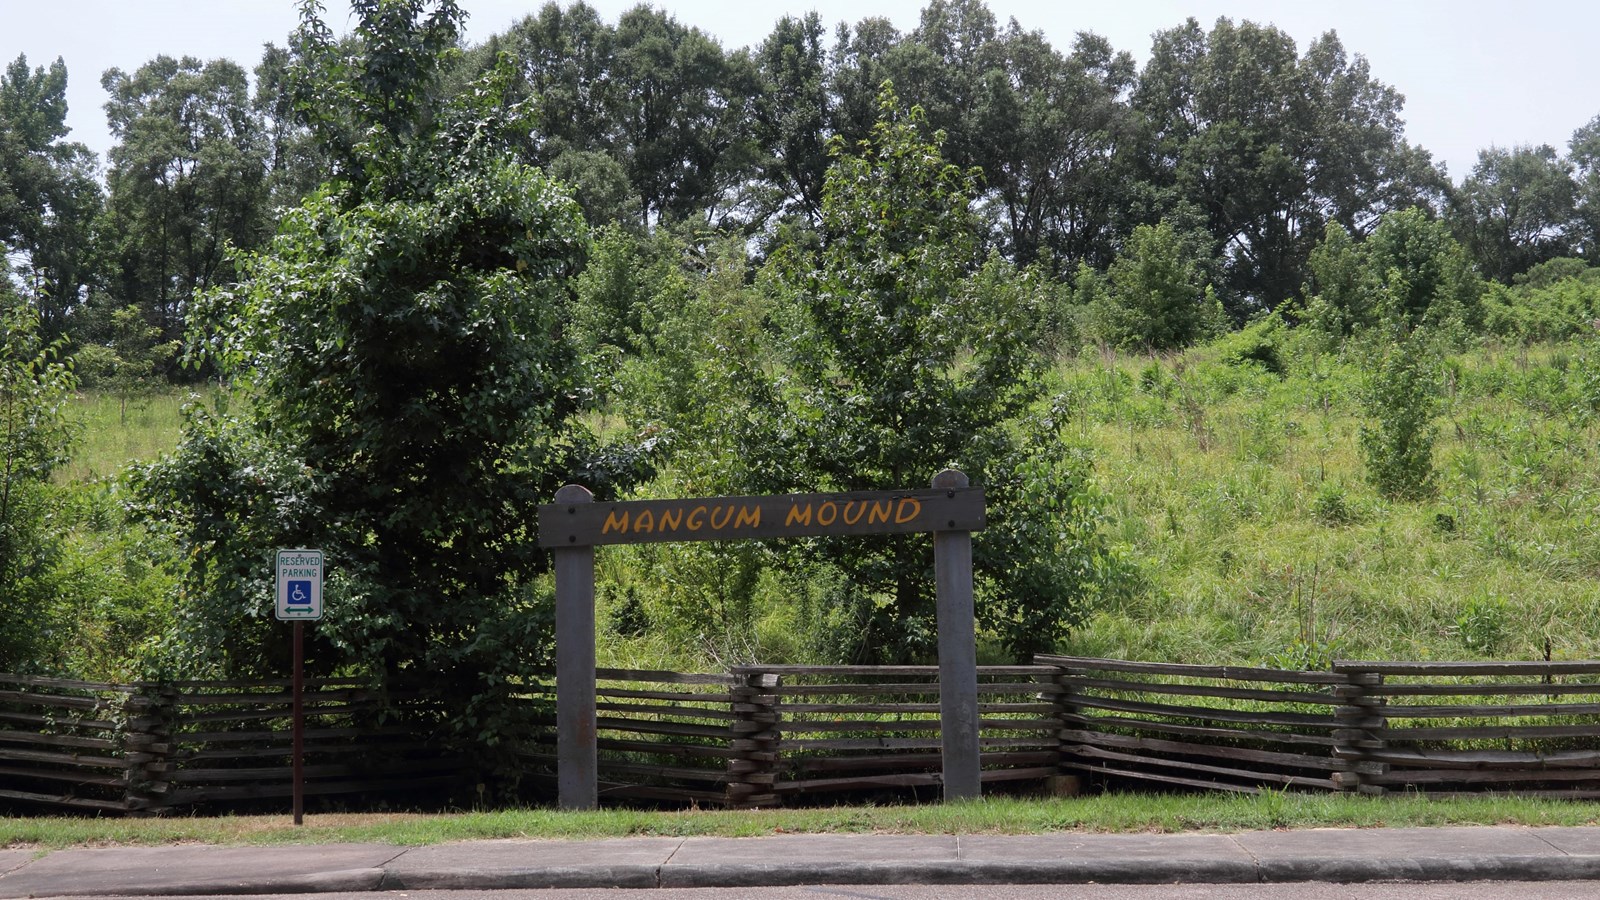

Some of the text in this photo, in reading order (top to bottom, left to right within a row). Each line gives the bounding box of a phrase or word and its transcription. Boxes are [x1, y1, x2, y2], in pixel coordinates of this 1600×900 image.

[602, 498, 921, 535] MANGUM MOUND
[280, 557, 320, 566] RESERVED
[282, 569, 317, 578] PARKING
